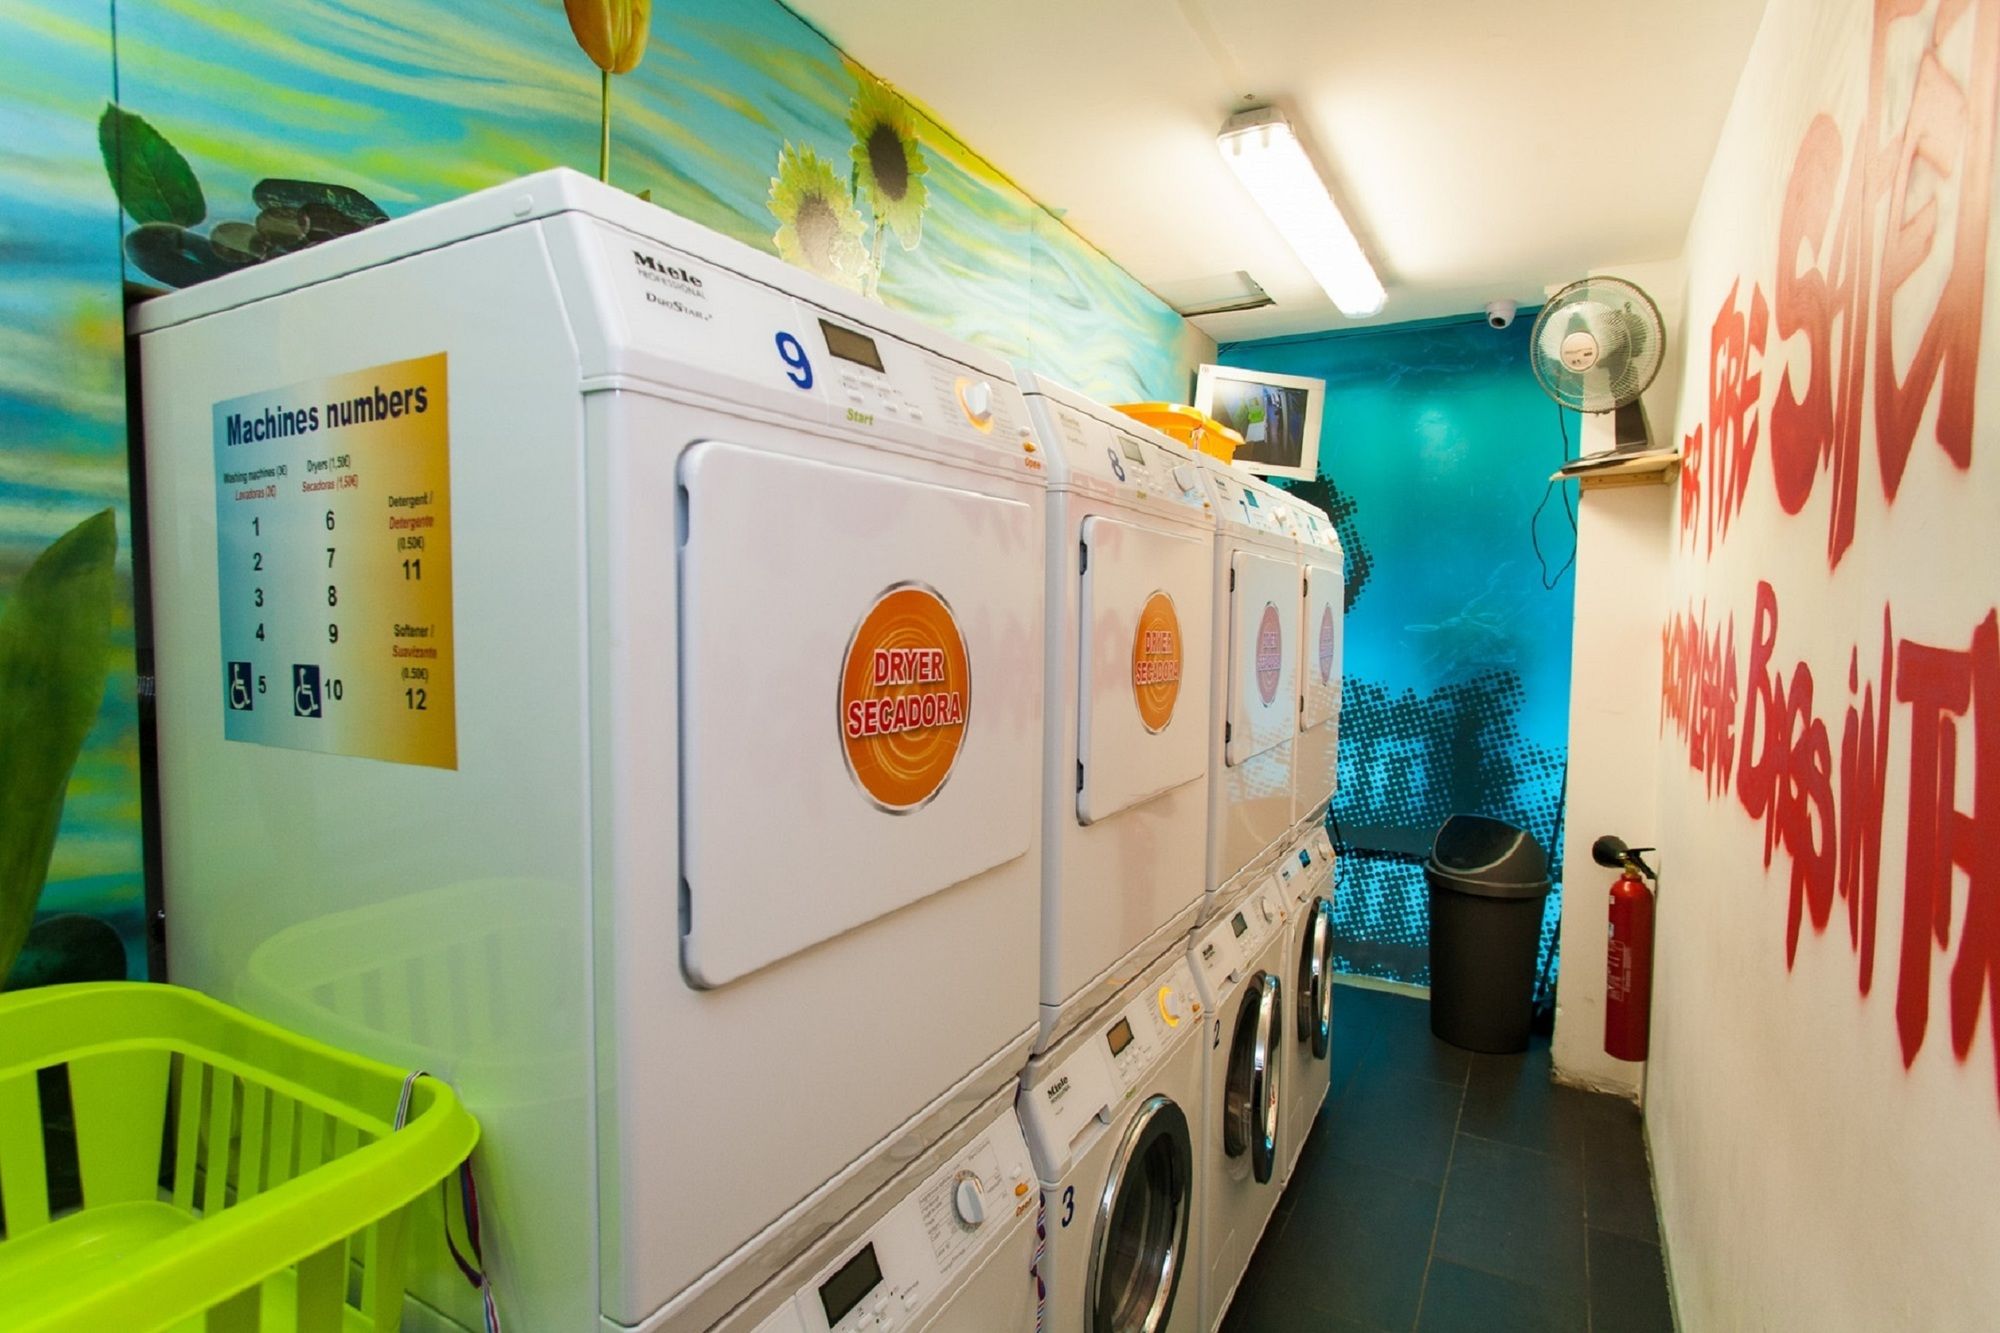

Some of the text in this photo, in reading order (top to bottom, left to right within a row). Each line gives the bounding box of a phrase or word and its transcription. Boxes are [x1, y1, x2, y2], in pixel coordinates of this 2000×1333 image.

[633, 250, 702, 288] Miele
[775, 332, 813, 390] 9
[226, 385, 428, 446] Machines numbers
[846, 408, 874, 426] Start
[307, 460, 328, 474] Dryers
[1024, 457, 1042, 470] Open
[1108, 448, 1125, 482] 8
[302, 480, 335, 492] Secadoras
[388, 492, 428, 509] Detergent
[252, 517, 260, 536] 1
[326, 510, 335, 530] 6
[389, 516, 434, 531] Detergente
[253, 552, 263, 571] 2
[327, 548, 336, 568] 7
[402, 558, 421, 580] 11
[254, 588, 264, 607] 3
[328, 585, 338, 606] 8
[255, 623, 265, 641] 4
[328, 624, 339, 643] 9
[393, 624, 429, 638] Softener
[1145, 631, 1173, 655] DRYER
[874, 648, 944, 686] DRYER
[1136, 660, 1179, 685] SECADORA
[258, 676, 267, 694] 5
[325, 679, 343, 700] 10
[405, 688, 427, 711] 12
[848, 692, 962, 738] SECADORA
[1736, 580, 1837, 974] BAGS
[1896, 606, 2000, 1126] TH
[1213, 1019, 1220, 1050] 2
[1047, 1076, 1068, 1099] Miele
[1062, 1185, 1075, 1227] 3
